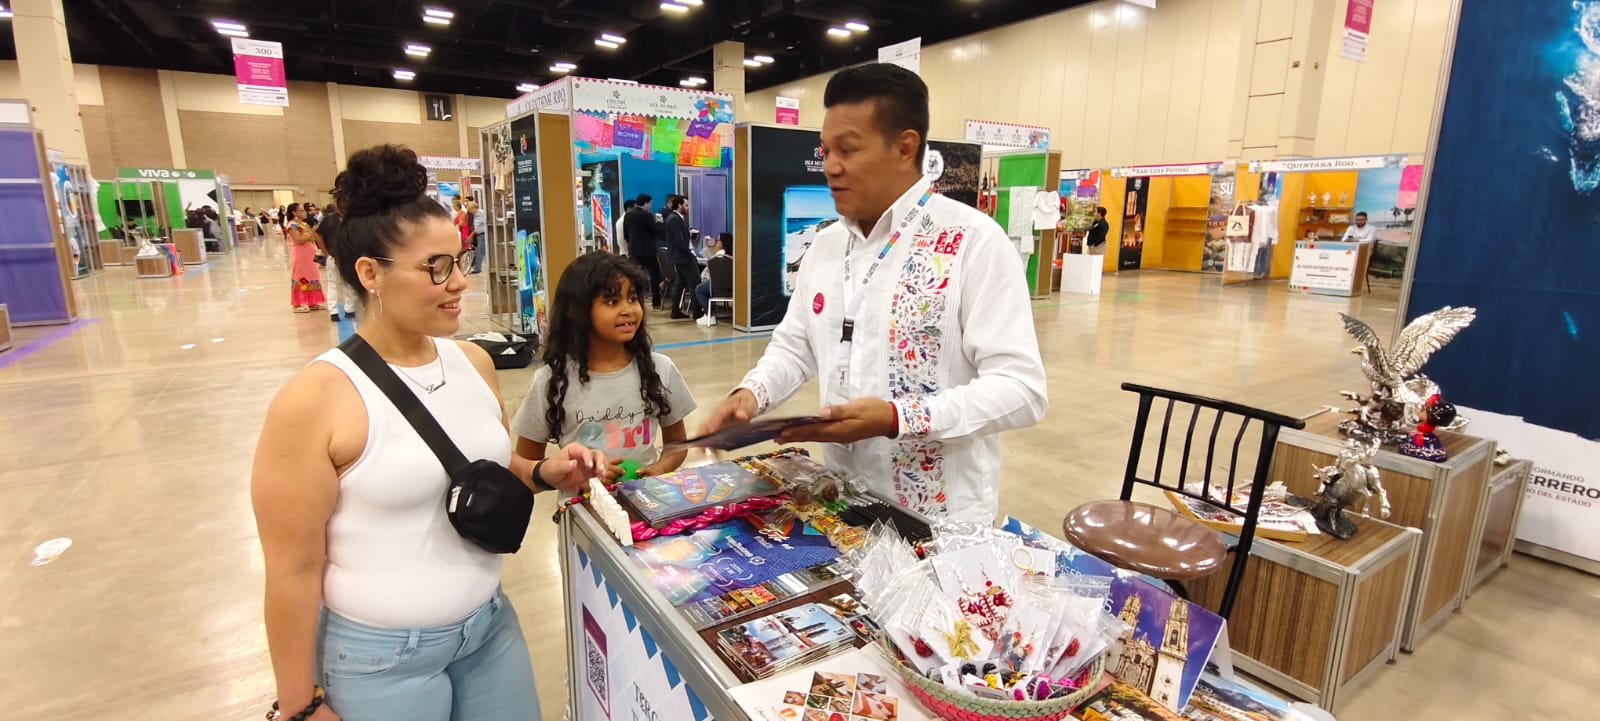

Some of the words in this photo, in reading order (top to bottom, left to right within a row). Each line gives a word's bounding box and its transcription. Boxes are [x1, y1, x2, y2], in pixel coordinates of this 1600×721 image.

[1287, 161, 1332, 169] QUINTANA
[1533, 467, 1584, 482] ORMANDO
[1528, 474, 1600, 500] ERRERO
[1537, 490, 1552, 499] DEL
[1556, 494, 1591, 508] ESTADO
